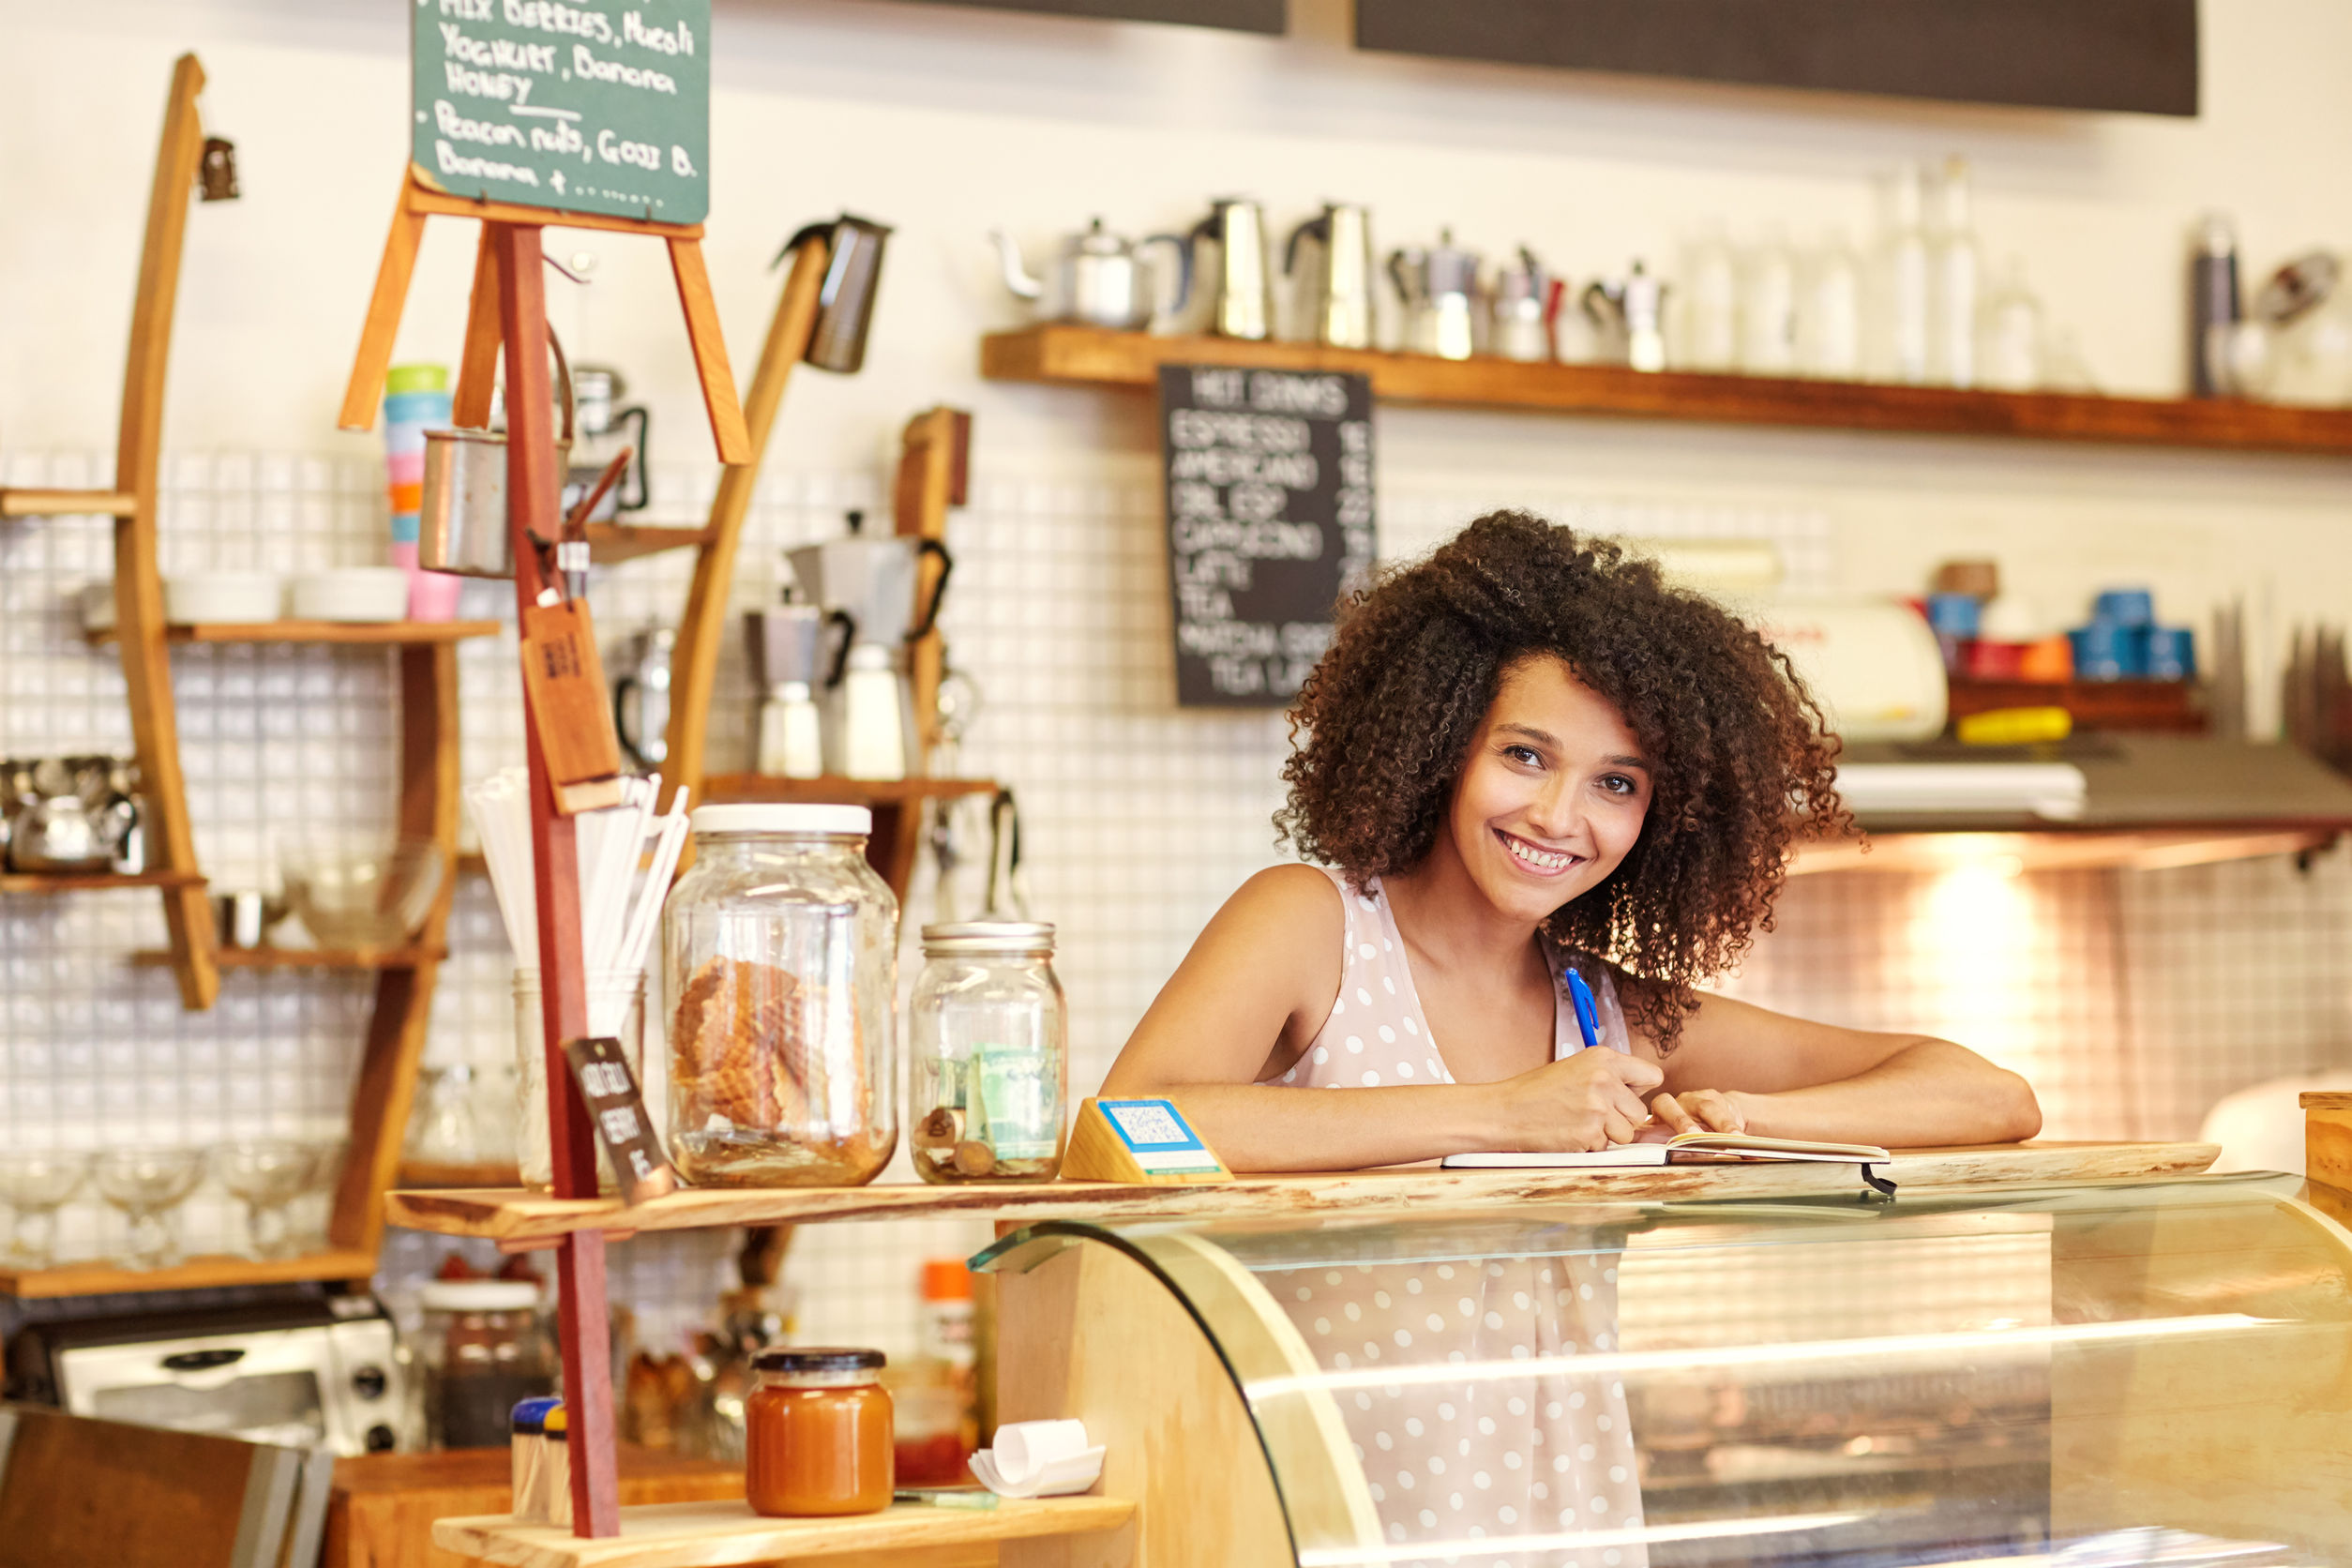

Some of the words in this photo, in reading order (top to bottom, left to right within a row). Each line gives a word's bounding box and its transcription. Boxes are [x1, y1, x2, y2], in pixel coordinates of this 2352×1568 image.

[444, 60, 533, 105] HONEY
[572, 43, 678, 96] Banana
[435, 139, 540, 188] Banana
